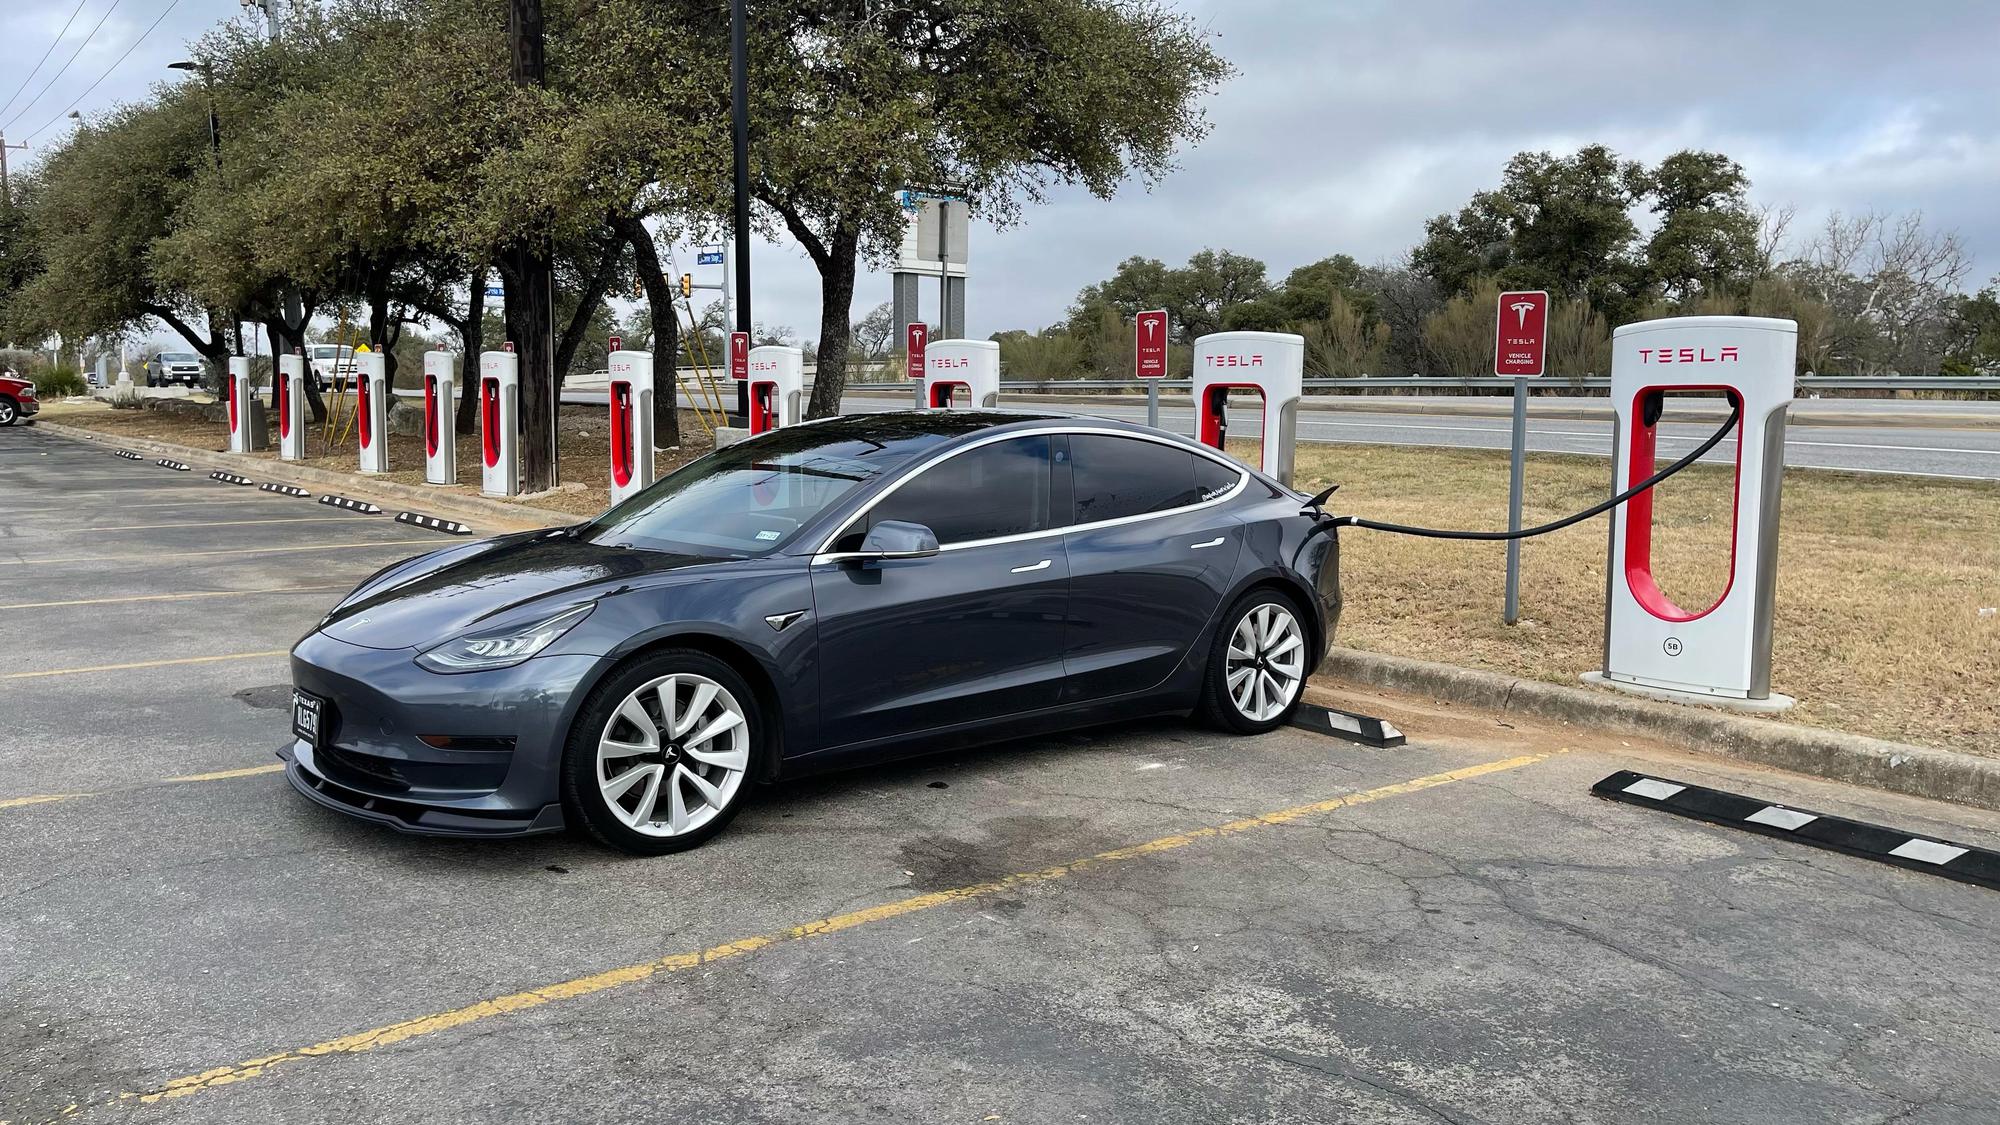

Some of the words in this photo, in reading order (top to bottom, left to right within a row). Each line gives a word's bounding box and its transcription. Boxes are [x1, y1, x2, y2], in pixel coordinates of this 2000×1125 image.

[1206, 355, 1263, 367] TESLA
[1639, 347, 1738, 364] TESLA
[751, 361, 777, 370] TESLA
[931, 358, 968, 368] TESLA
